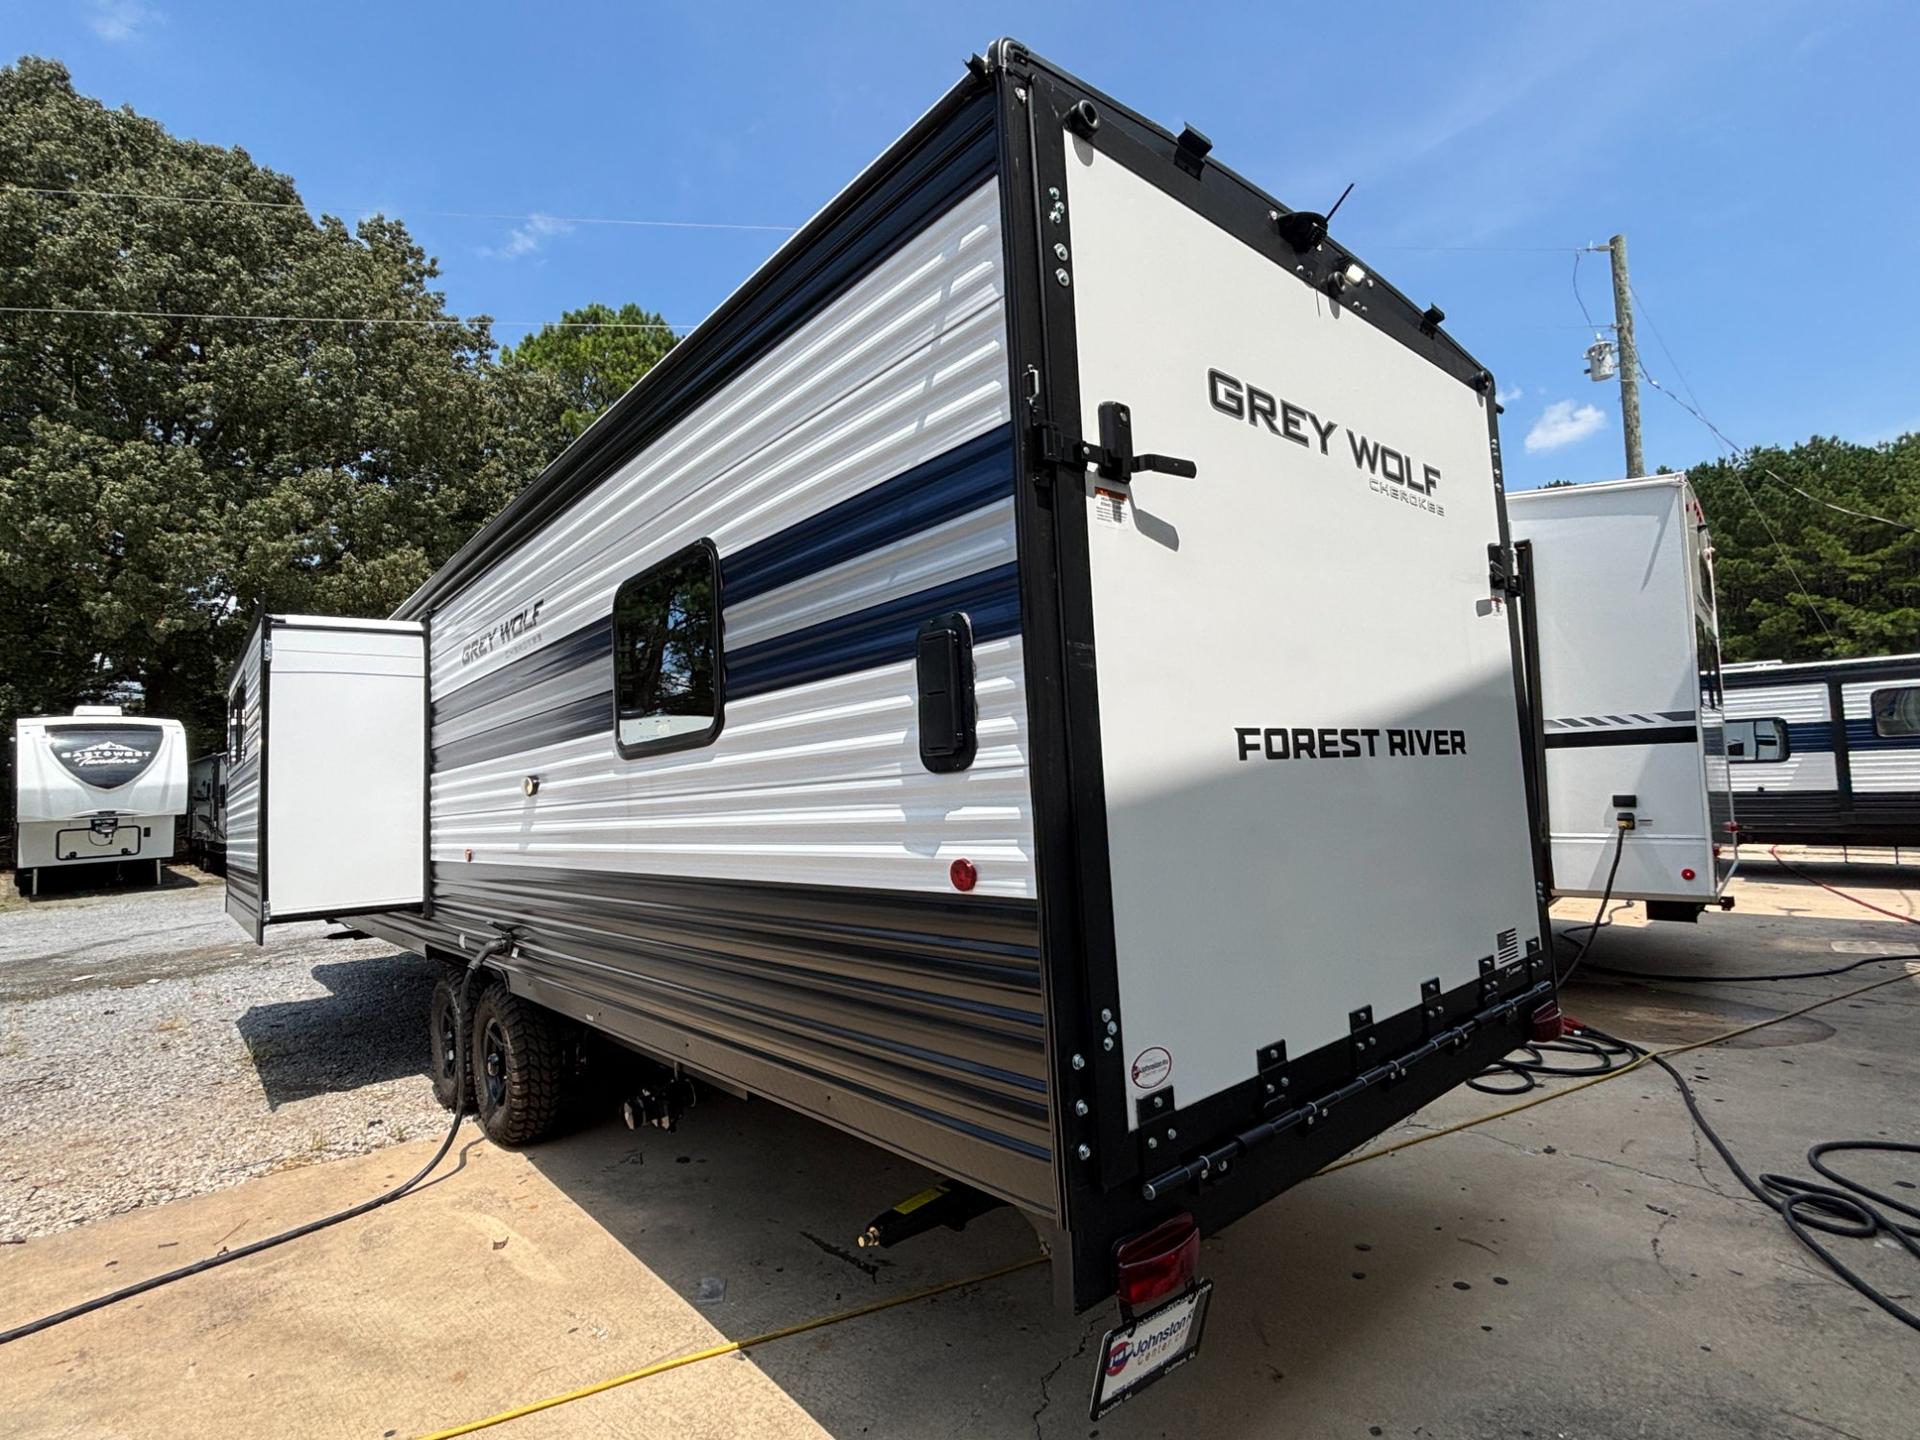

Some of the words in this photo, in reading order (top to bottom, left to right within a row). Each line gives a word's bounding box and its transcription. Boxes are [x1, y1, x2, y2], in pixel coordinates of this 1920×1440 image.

[1208, 367, 1338, 456] GREY
[1346, 428, 1442, 497] WOLF
[1368, 477, 1446, 518] CHEROKEE
[461, 627, 498, 666] GREY
[500, 598, 545, 645] WOLF
[1233, 727, 1380, 762] FOREST
[1385, 728, 1467, 757] RIVER
[1132, 1316, 1187, 1358] Johnston
